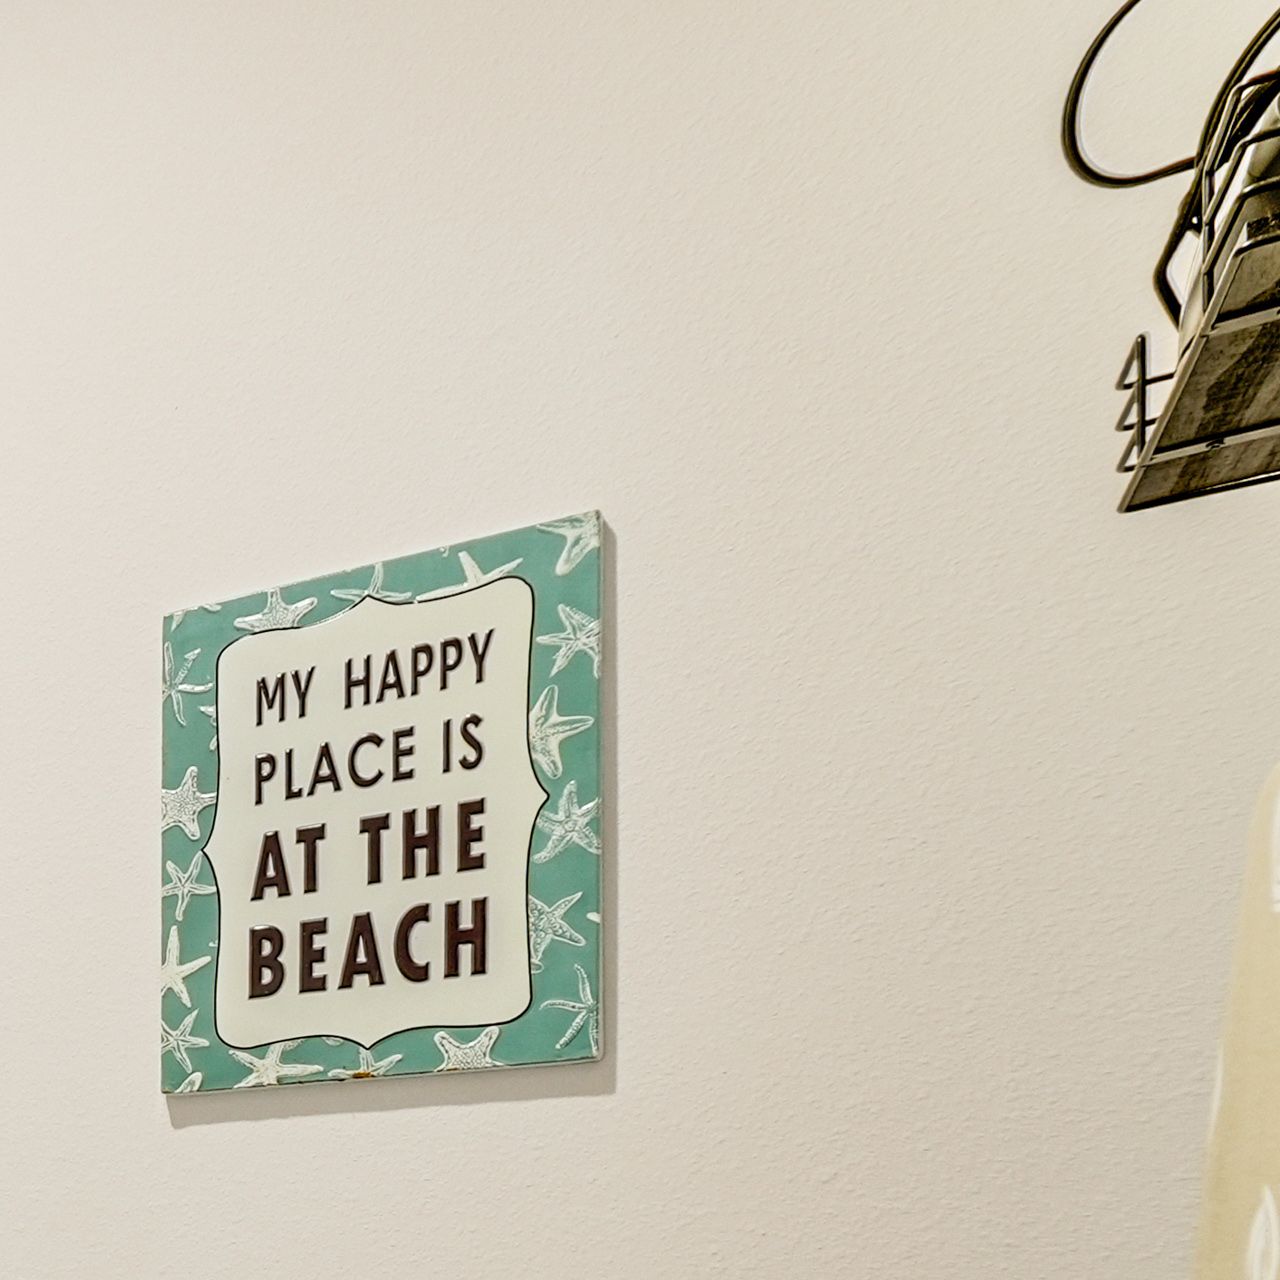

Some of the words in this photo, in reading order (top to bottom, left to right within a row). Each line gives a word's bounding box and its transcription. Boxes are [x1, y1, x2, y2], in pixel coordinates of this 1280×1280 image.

[255, 666, 316, 728] MY
[343, 628, 496, 709] HAPPY
[254, 726, 417, 806] PLACE
[441, 713, 485, 773] IS
[250, 823, 326, 902] AT
[359, 798, 488, 885] THE
[248, 897, 488, 1000] BEACH
